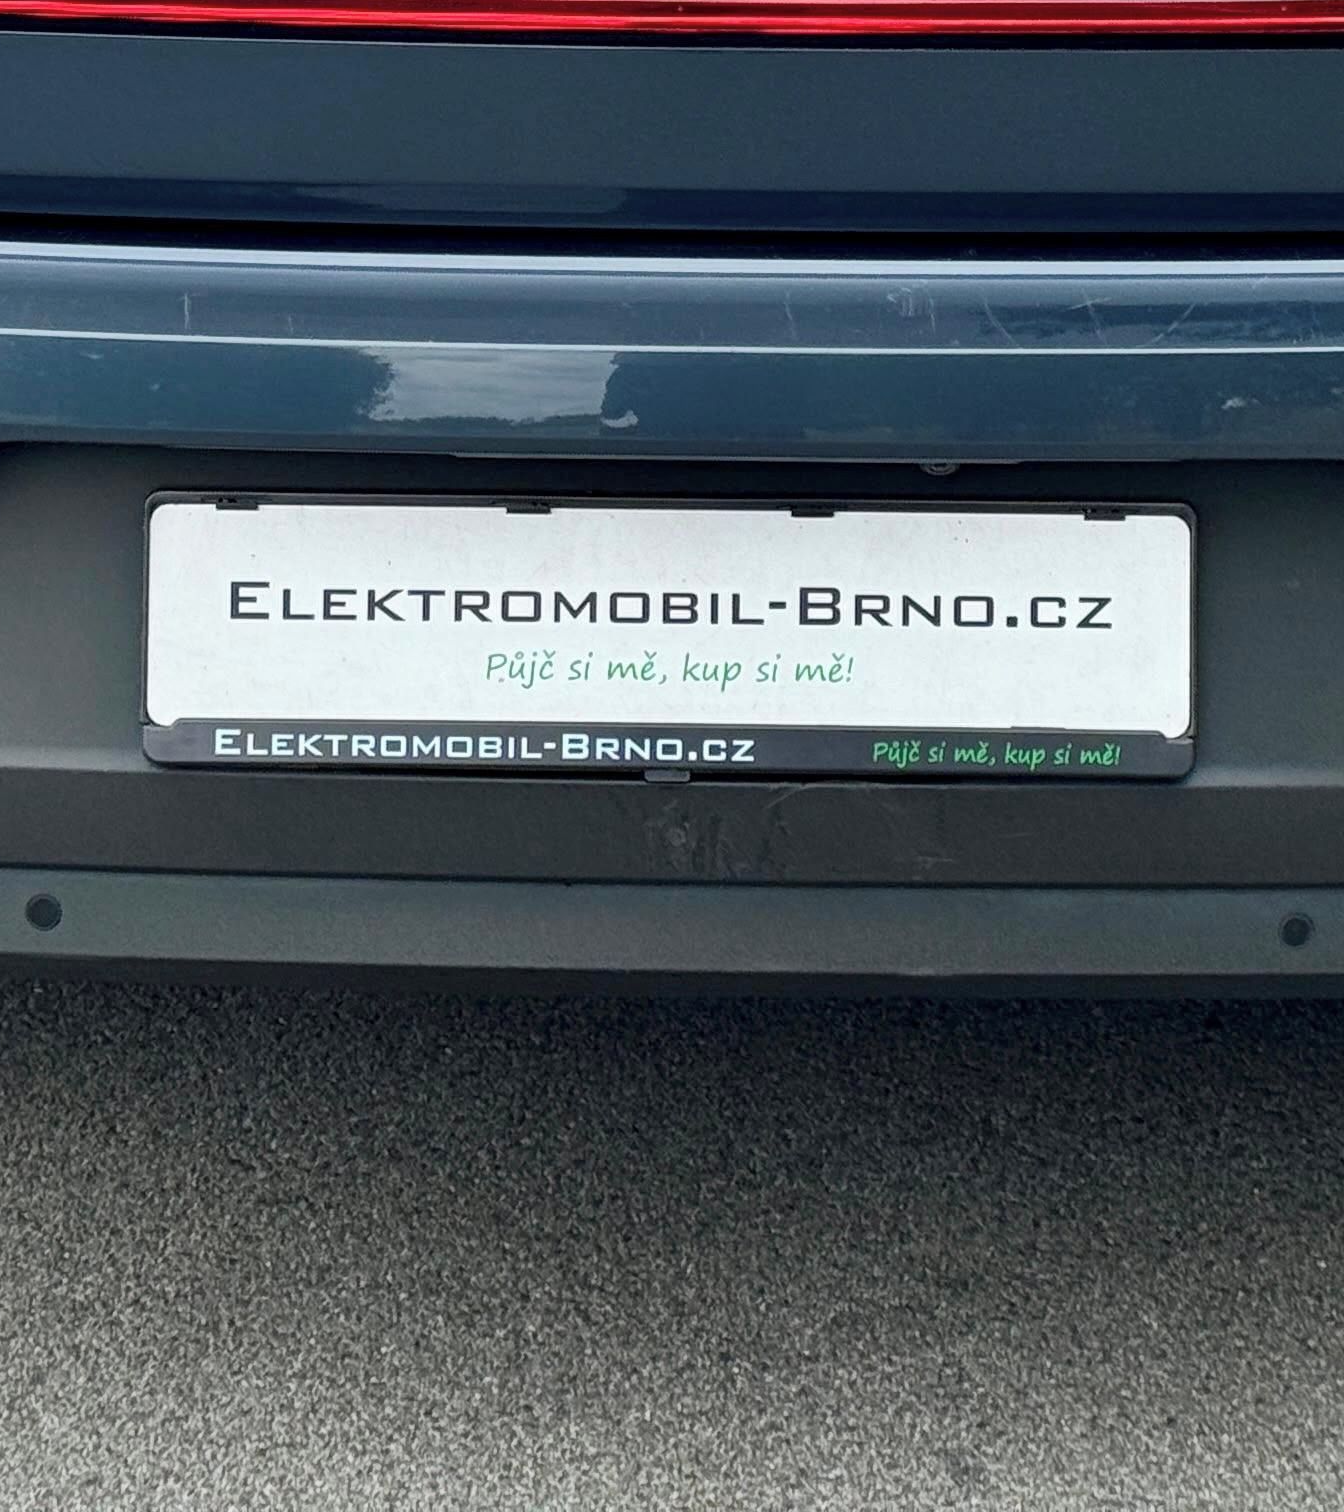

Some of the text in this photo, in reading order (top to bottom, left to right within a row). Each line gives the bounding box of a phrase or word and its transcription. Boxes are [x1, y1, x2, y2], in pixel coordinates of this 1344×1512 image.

[485, 649, 855, 692] Půjč si mě, kup si mě!
[872, 740, 1121, 771] Půjč si mě, kup si mě!
